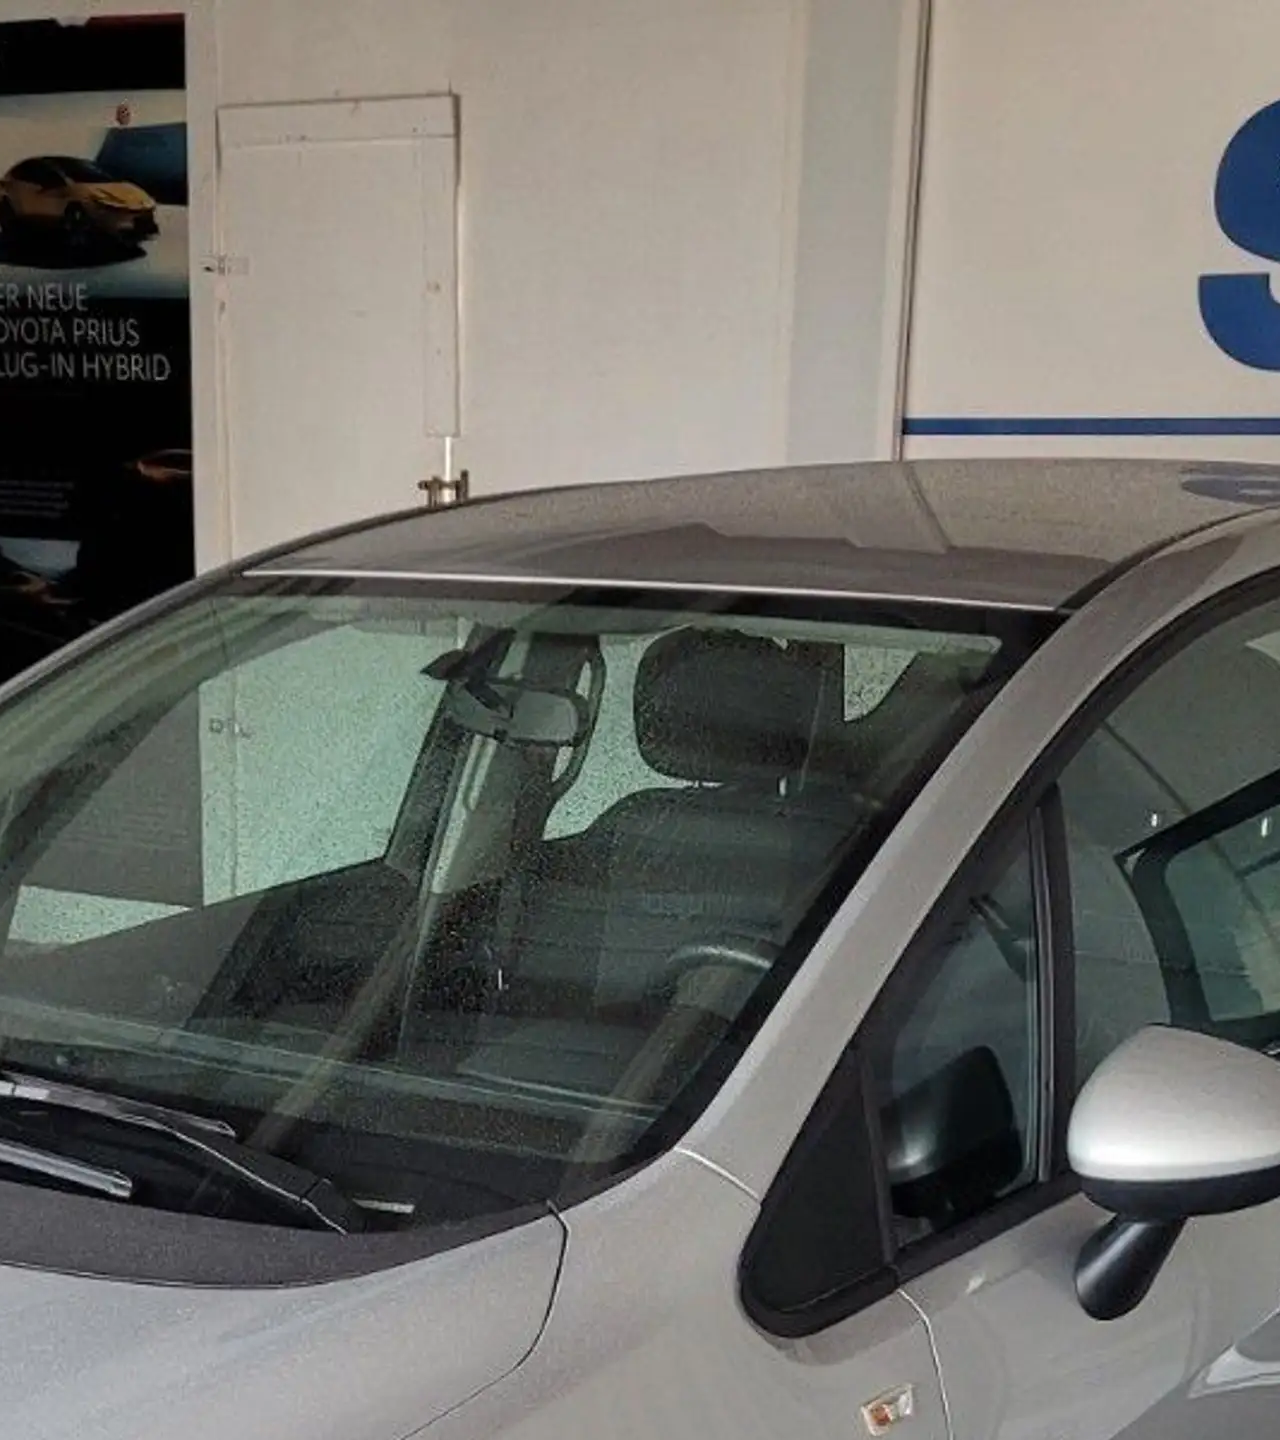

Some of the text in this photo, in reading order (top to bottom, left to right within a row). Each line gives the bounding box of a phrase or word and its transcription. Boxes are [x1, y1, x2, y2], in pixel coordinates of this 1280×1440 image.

[27, 282, 89, 312] NEUE
[73, 317, 141, 347] PRIUS
[82, 353, 171, 381] HYBRID
